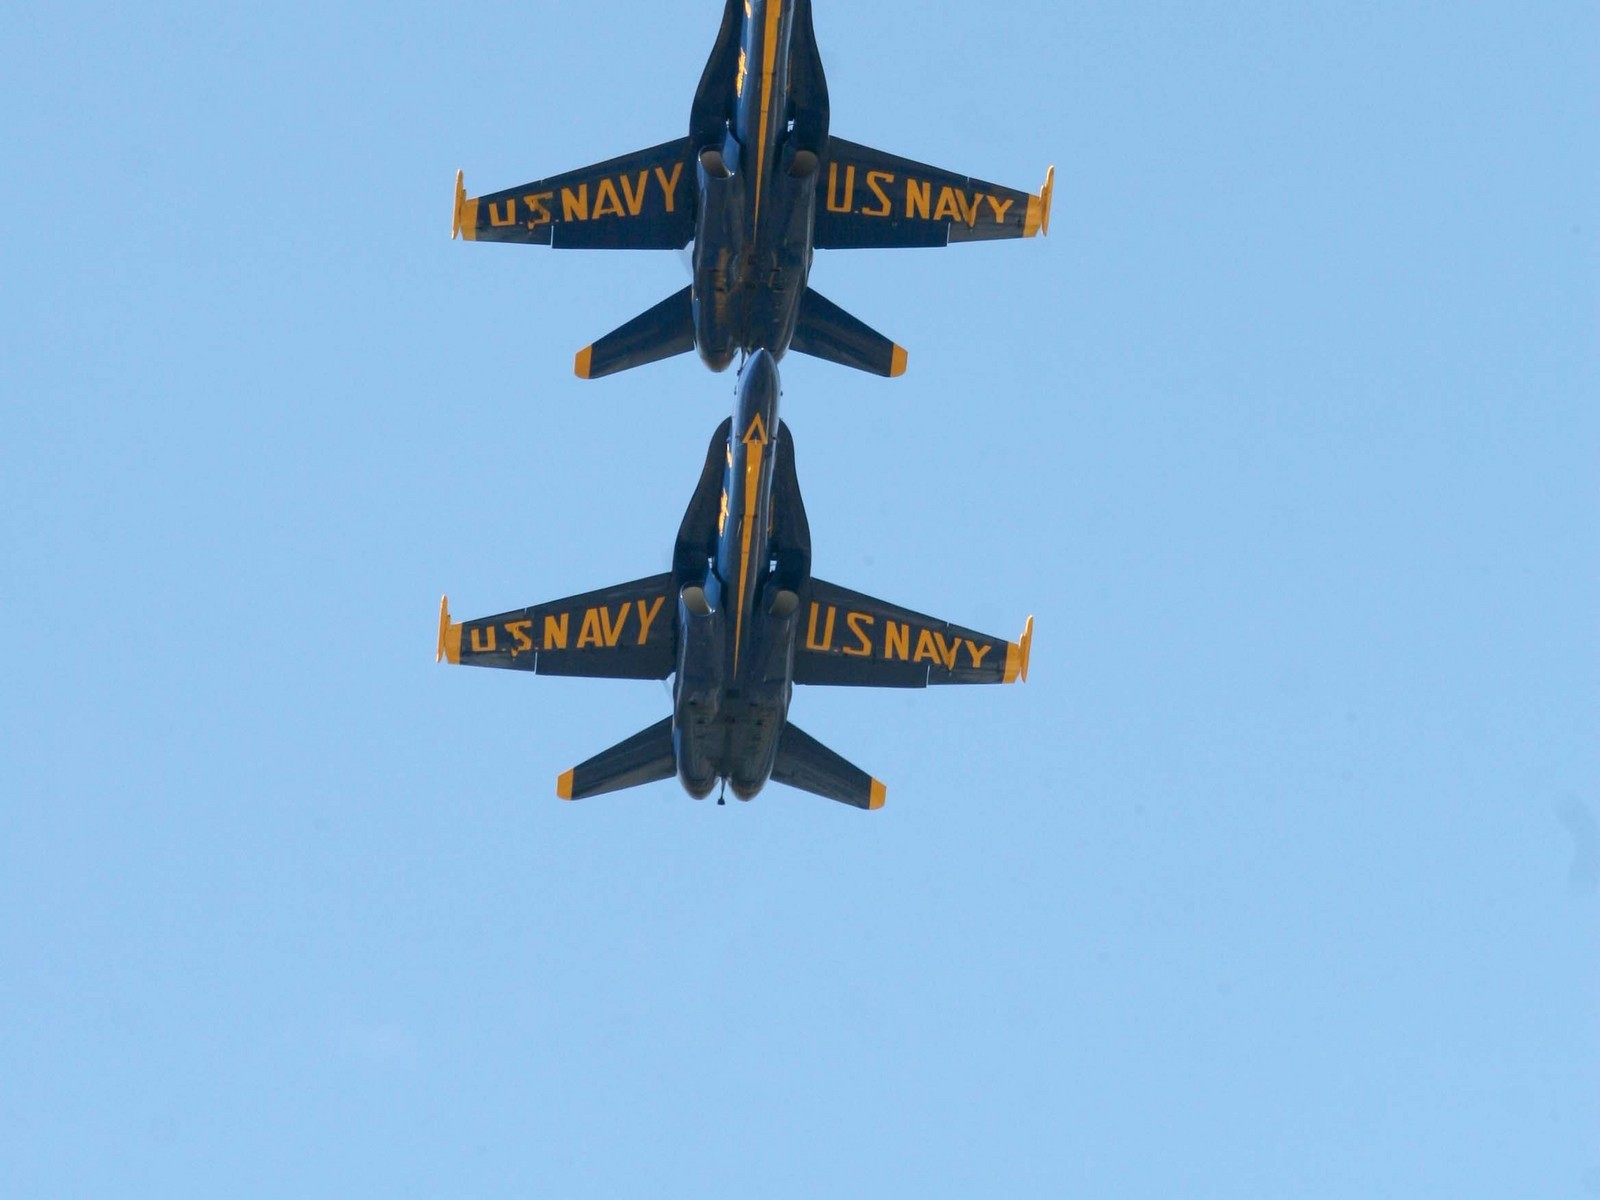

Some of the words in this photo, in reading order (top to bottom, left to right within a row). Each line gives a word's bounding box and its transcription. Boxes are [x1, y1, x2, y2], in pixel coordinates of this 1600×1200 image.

[561, 163, 682, 221] NAVY
[905, 178, 1013, 227] NAVY
[543, 596, 664, 650] NAVY
[884, 619, 991, 670] NAVY
